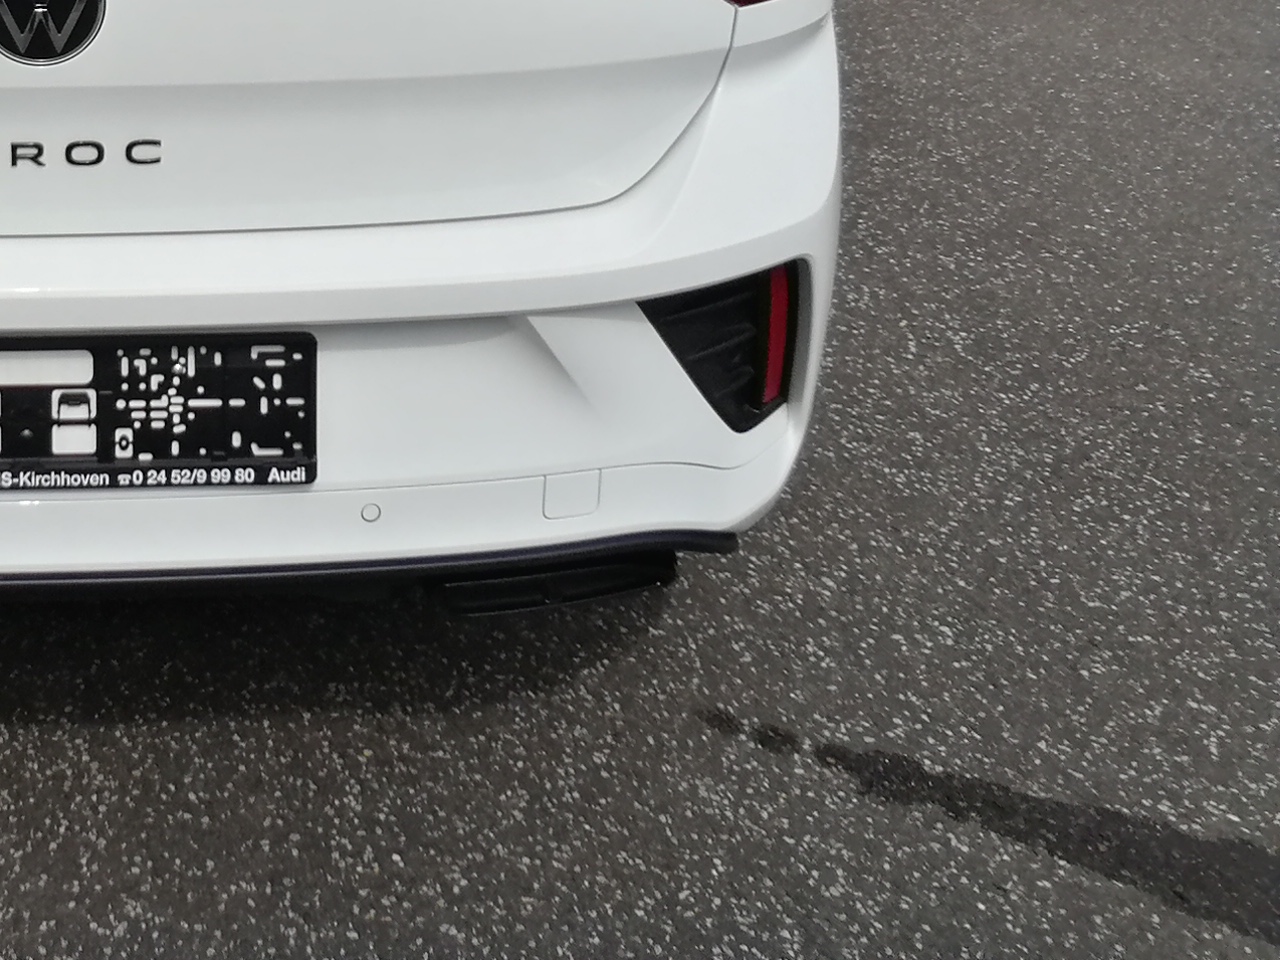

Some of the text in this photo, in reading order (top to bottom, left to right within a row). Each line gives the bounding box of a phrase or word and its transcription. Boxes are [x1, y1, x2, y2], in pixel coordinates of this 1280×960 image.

[147, 470, 167, 485] 24
[170, 468, 207, 484] 52/9
[210, 468, 231, 483] 99
[234, 467, 255, 482] 80
[267, 466, 306, 482] Audi
